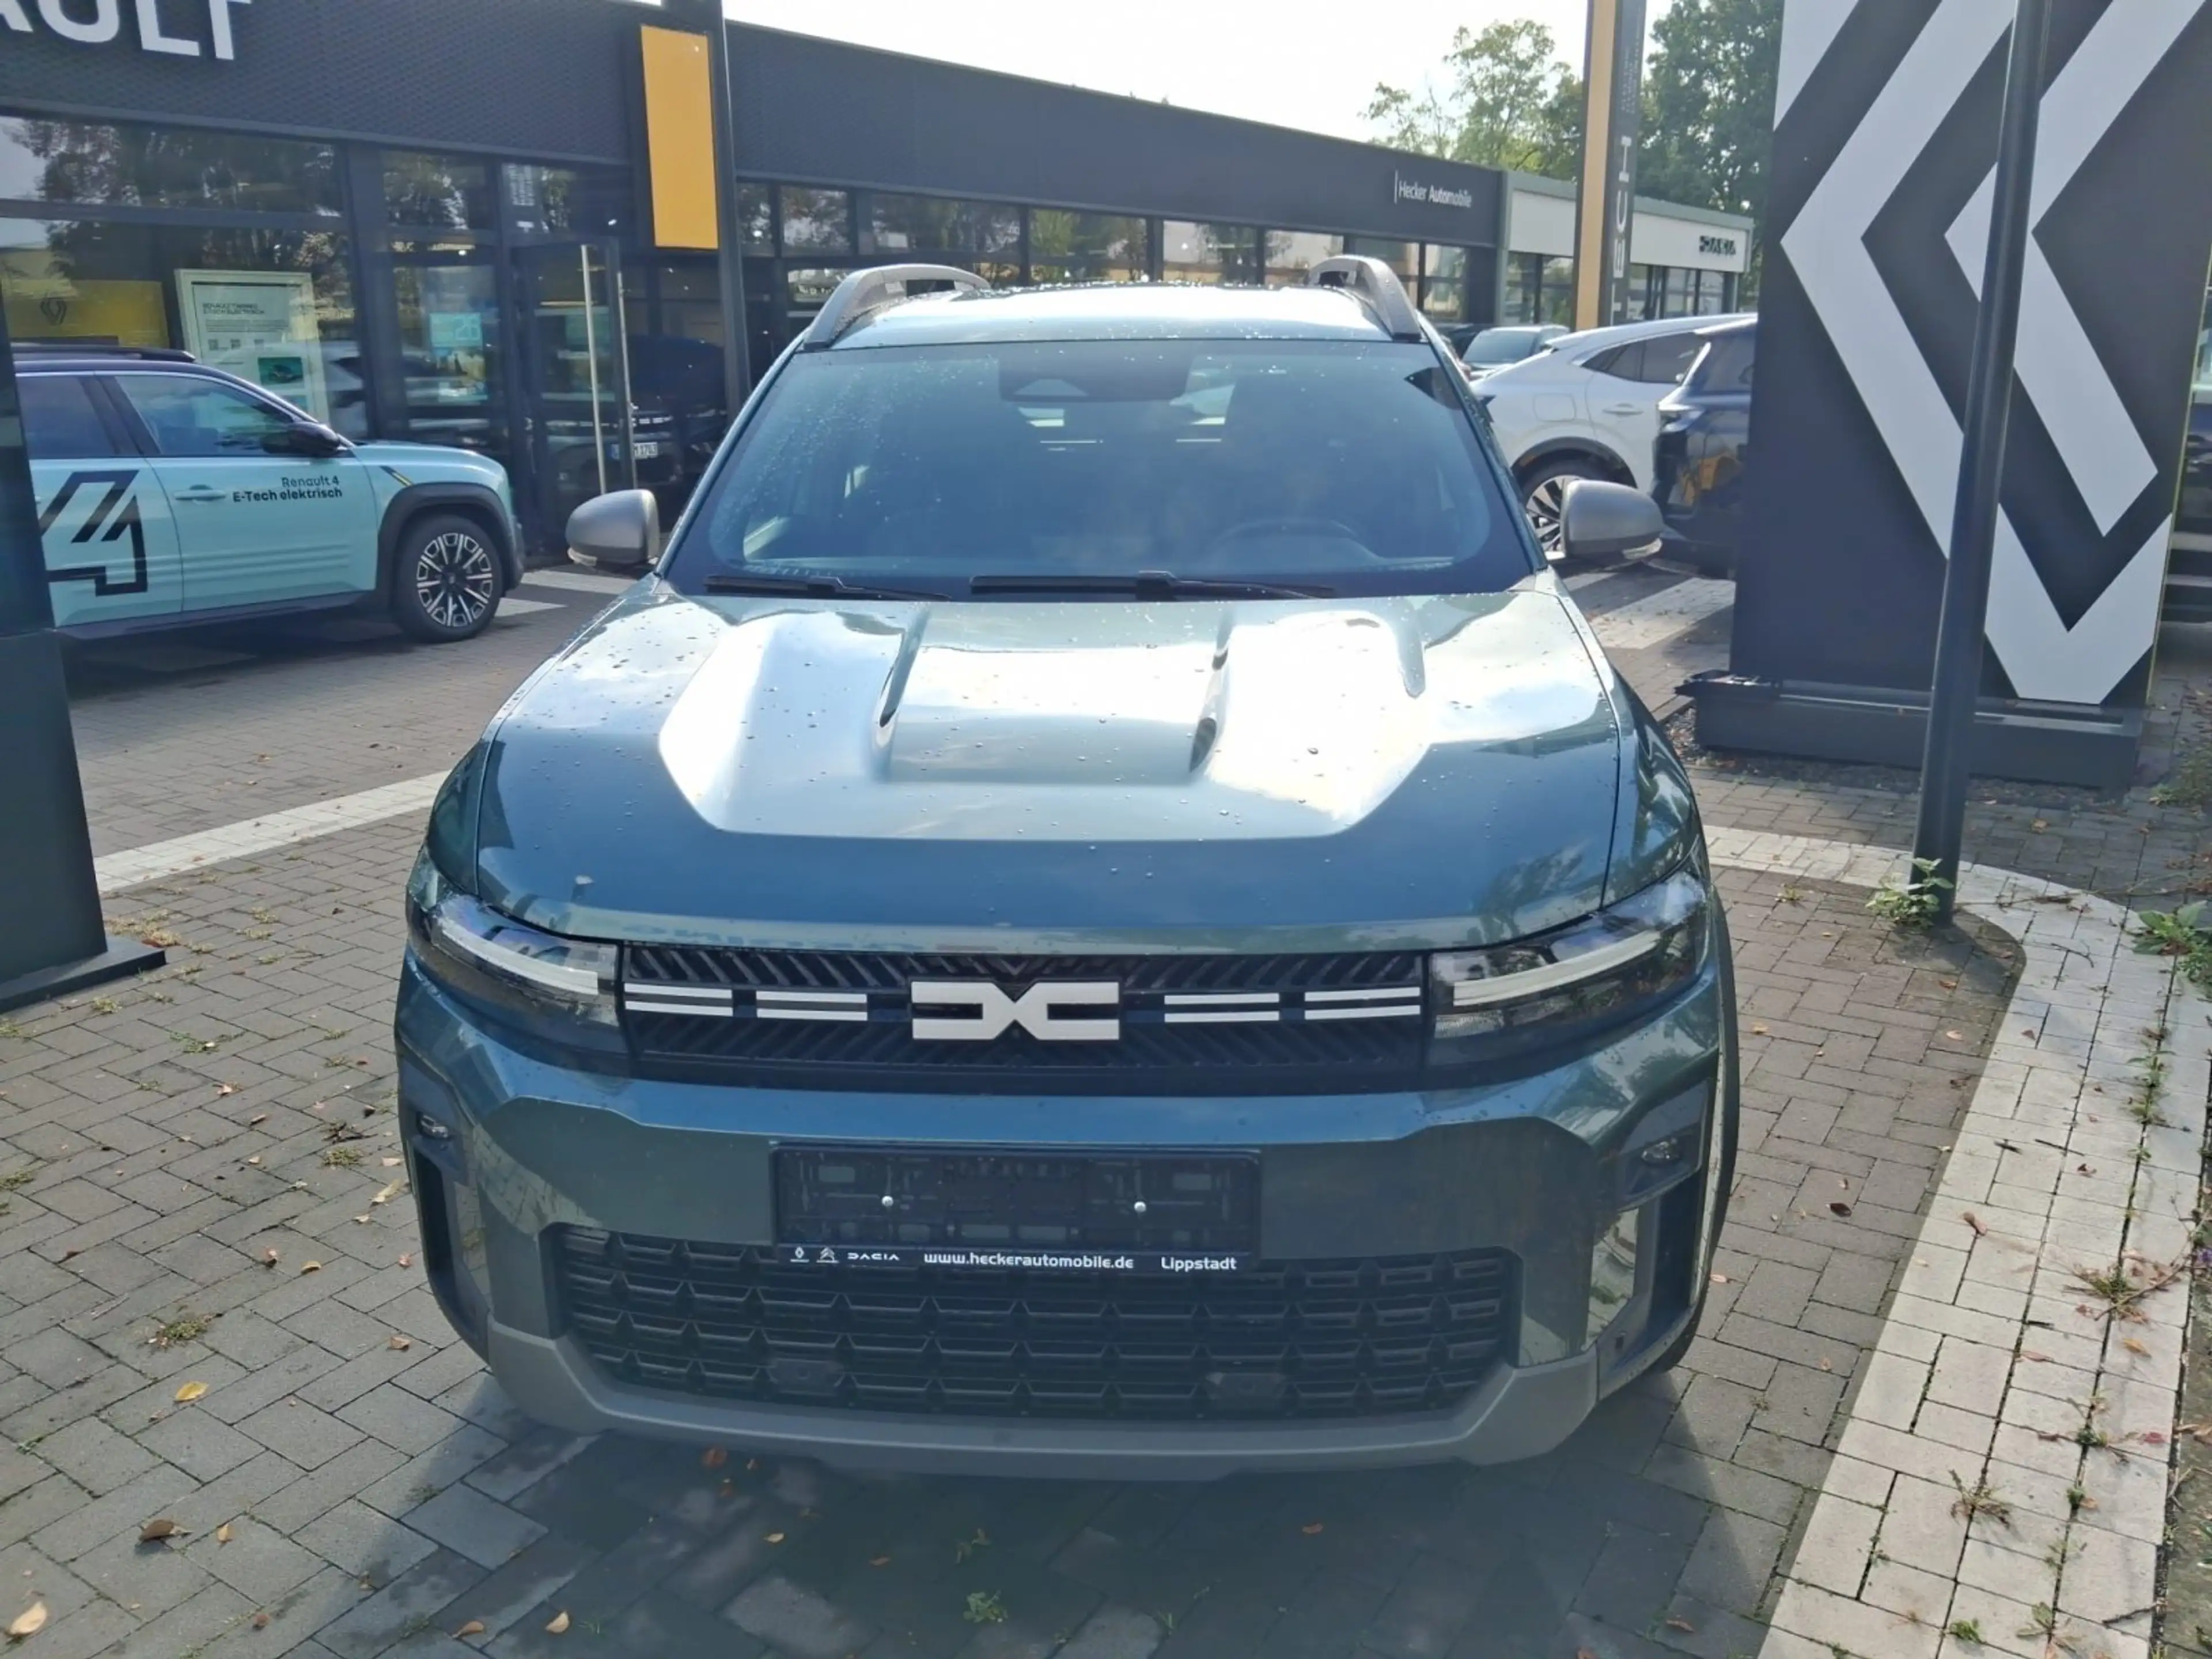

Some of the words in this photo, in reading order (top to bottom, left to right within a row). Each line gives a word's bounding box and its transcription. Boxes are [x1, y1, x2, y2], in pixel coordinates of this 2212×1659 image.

[0, 0, 252, 60] ULT
[1399, 180, 1427, 200] Hecker
[281, 475, 330, 487] Renault
[332, 475, 340, 486] 4
[233, 489, 278, 503] E-Tech
[280, 487, 343, 501] elektrisch
[847, 1252, 900, 1262] DACIA
[923, 1252, 1134, 1270] www.heckerautomobile.de
[1161, 1256, 1237, 1272] Lippstadt
